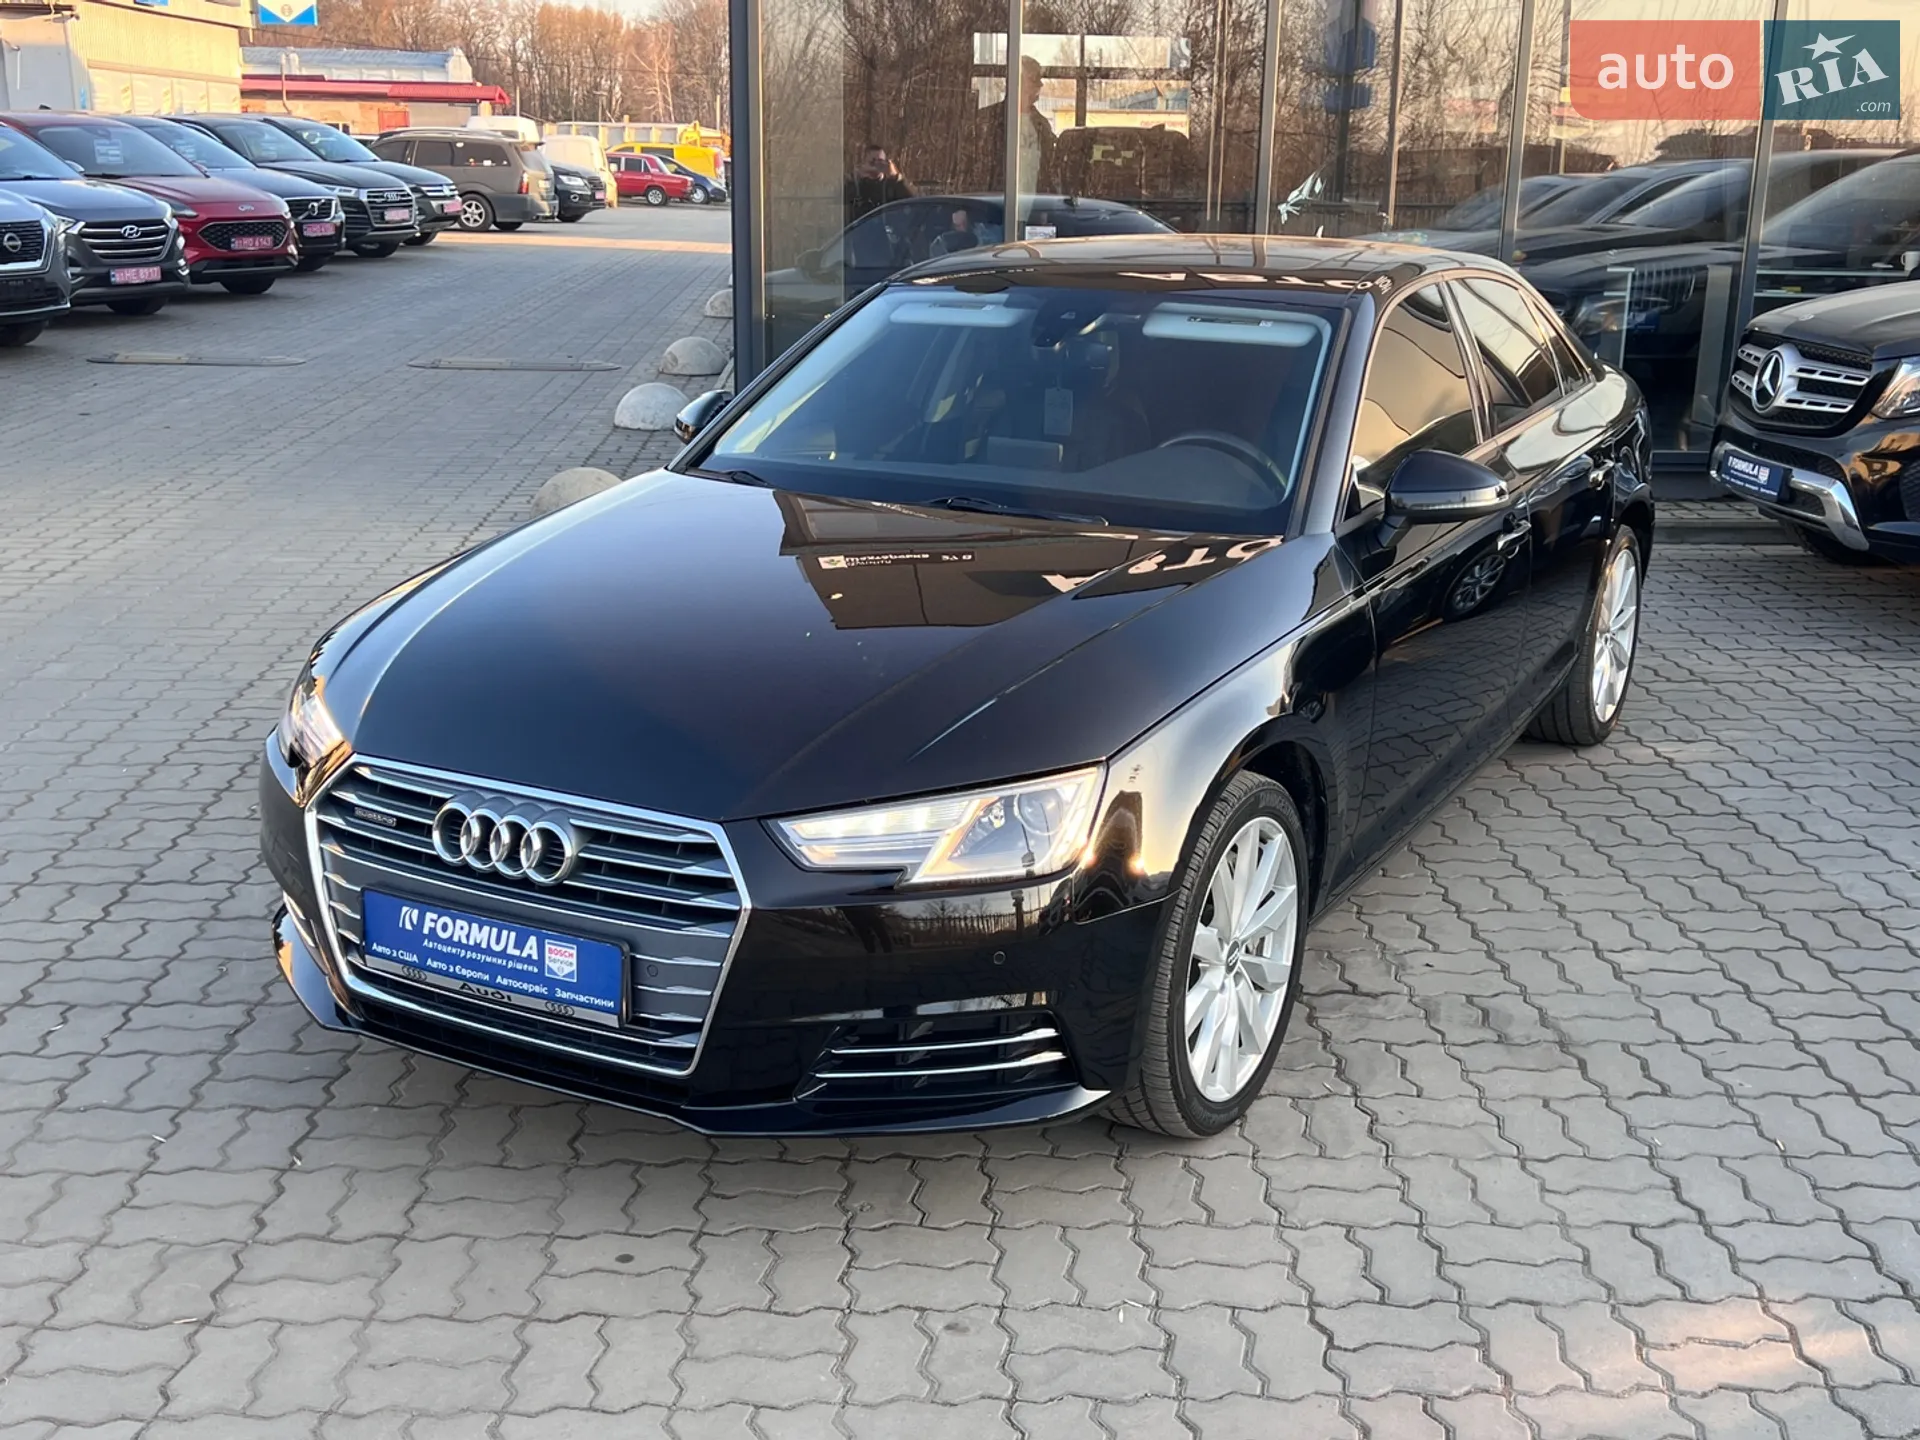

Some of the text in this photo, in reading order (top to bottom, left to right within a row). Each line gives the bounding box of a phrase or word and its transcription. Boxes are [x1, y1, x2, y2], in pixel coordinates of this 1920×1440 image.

[422, 911, 539, 960] FORMULA
[371, 942, 393, 956] Авто
[398, 951, 419, 964] США
[422, 937, 539, 973] Автоцентр розумних рішень
[547, 946, 575, 960] BOSCH
[547, 954, 575, 968] Service
[426, 957, 447, 970] Авто
[455, 965, 490, 981] Європи
[458, 982, 513, 1002] Audi
[495, 974, 549, 995] Автосервіс
[555, 987, 615, 1008] Запчастини
